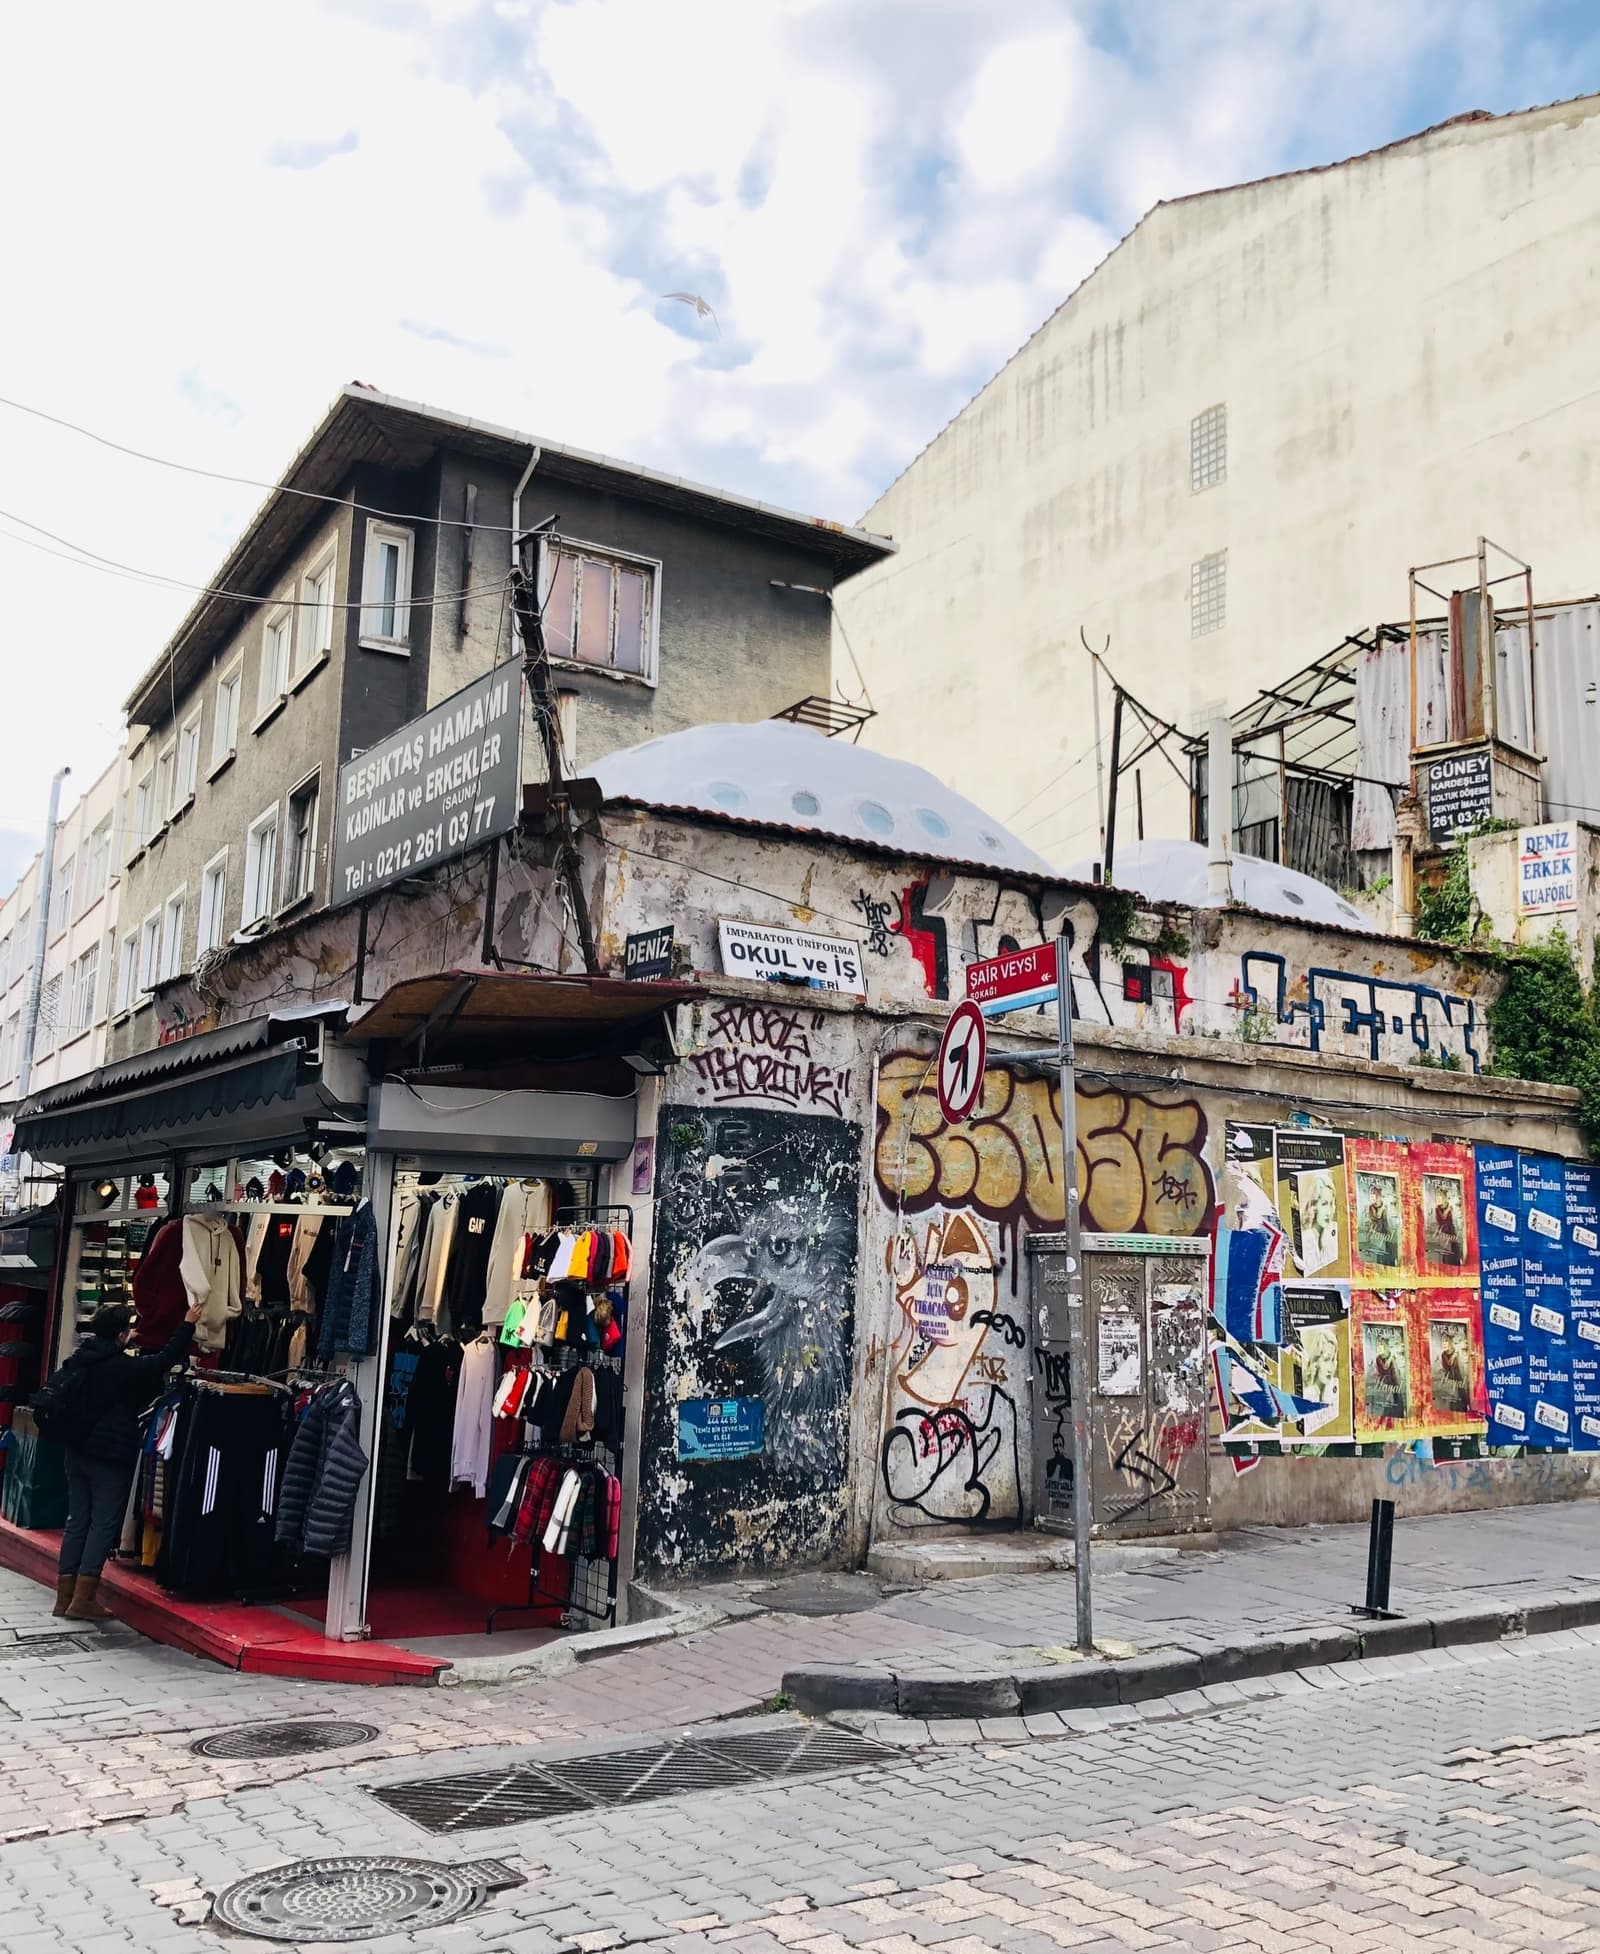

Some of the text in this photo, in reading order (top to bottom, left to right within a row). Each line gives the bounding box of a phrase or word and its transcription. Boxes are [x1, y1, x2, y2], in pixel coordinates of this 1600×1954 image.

[429, 680, 509, 759] HAMAMI
[1430, 756, 1489, 780] GÜNEY
[346, 734, 501, 843] KADINLAR ve ERKEKLER
[1431, 773, 1489, 791] KARDEŞLER
[442, 781, 482, 815] (SAUNA)
[1431, 791, 1458, 803] KOLTUK
[1431, 802, 1460, 815] ÇEKYAT
[1432, 815, 1453, 828] 261
[1458, 810, 1472, 824] 03
[345, 860, 364, 893] Tel
[376, 838, 412, 879] 0212
[415, 824, 443, 862] 261
[448, 811, 469, 847] 03
[474, 796, 496, 834] 77
[1526, 829, 1569, 853] DENİZ
[1523, 858, 1572, 880] ERKEK
[1522, 879, 1573, 906] KUAFÖRÜ
[726, 924, 855, 956] İMPARATOR ÜNİFORMA
[627, 931, 670, 966] DENİZ
[730, 942, 858, 983] OKUL ve İŞ
[970, 952, 1036, 990] ŞAİR VEYSİ
[1479, 1160, 1513, 1172] Kokumu
[1522, 1164, 1540, 1176] Beni
[1484, 1176, 1512, 1188] özledin
[1565, 1171, 1591, 1181] Haberin
[1522, 1177, 1561, 1191] hatırladın
[1480, 1189, 1495, 1201] mi?
[1566, 1214, 1584, 1225] gerek
[1482, 1258, 1518, 1272] Kokumu
[1525, 1259, 1543, 1271] Beni
[1569, 1265, 1594, 1275] Haberin
[1487, 1275, 1517, 1286] özledin
[1525, 1272, 1563, 1285] hatırladın
[1484, 1288, 1499, 1300] mi?
[1571, 1309, 1588, 1320] gerek
[1487, 1356, 1522, 1370] Kokumu
[1529, 1355, 1547, 1367] Beni
[1573, 1359, 1598, 1369] Haberin
[1493, 1373, 1522, 1385] özledin
[1529, 1368, 1569, 1382] hatırladın
[1488, 1387, 1504, 1399] mi?
[1529, 1382, 1545, 1394] mı?
[1574, 1404, 1592, 1415] gerek
